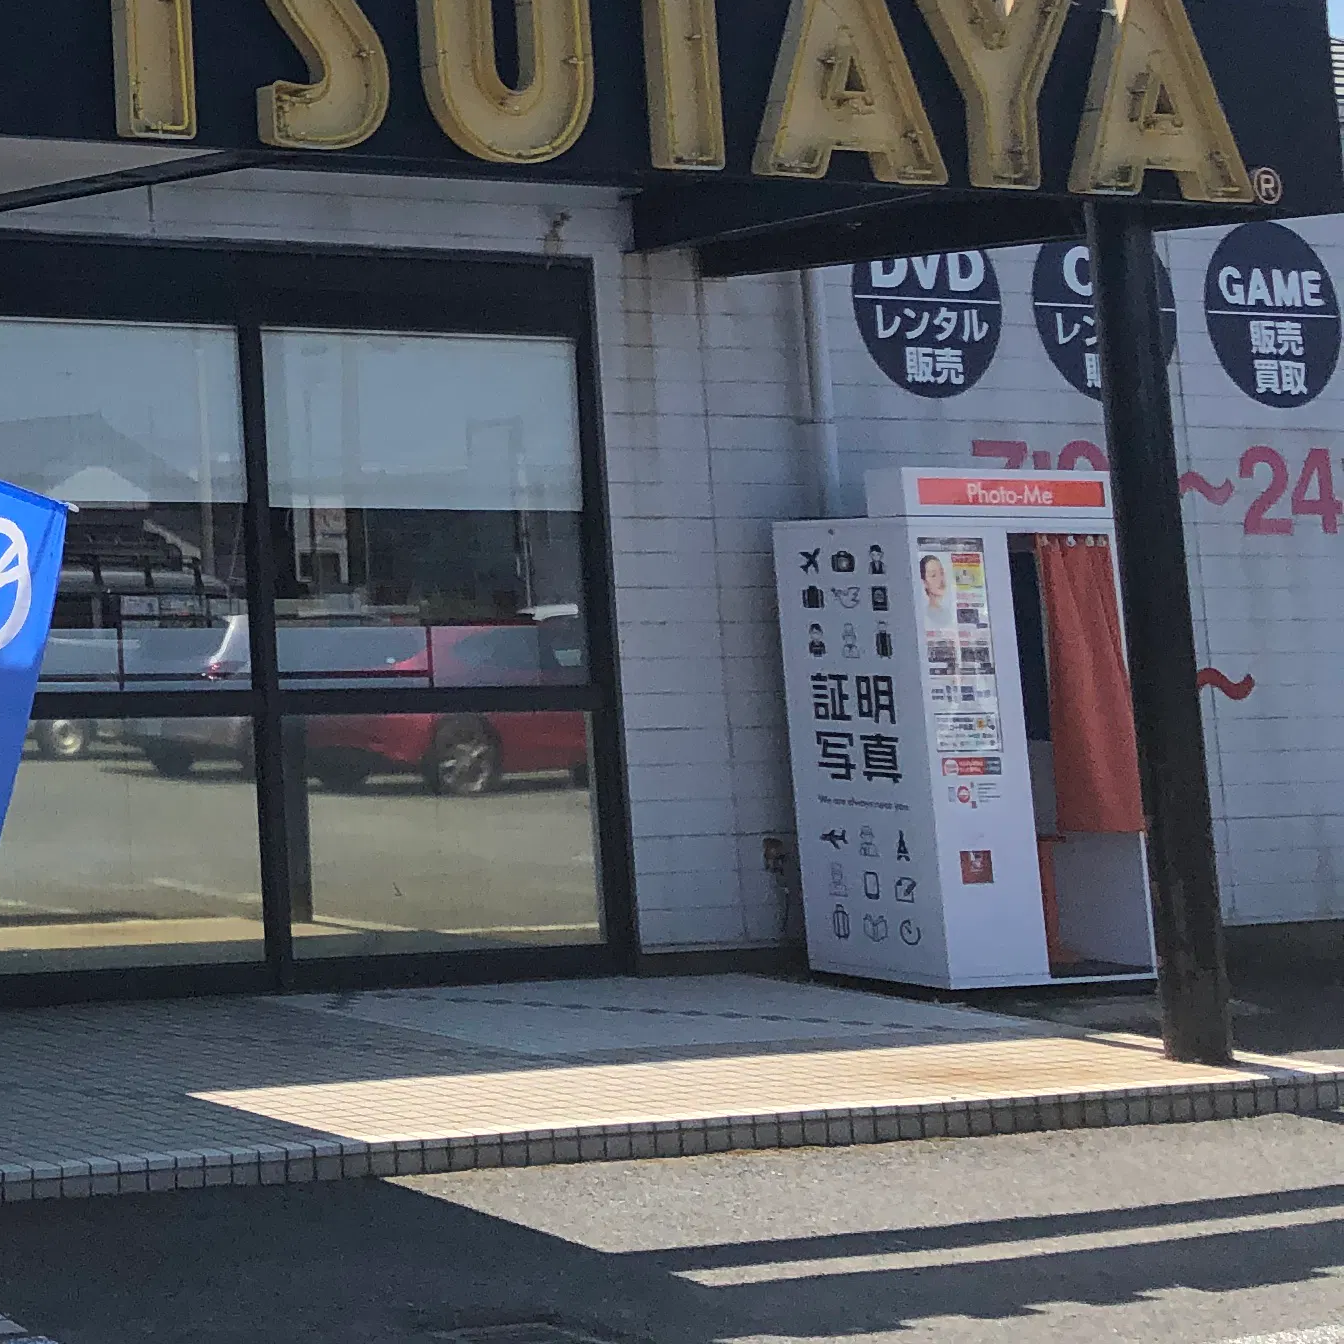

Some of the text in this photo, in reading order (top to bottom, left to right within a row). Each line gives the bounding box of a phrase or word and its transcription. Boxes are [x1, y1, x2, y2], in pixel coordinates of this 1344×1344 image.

[870, 248, 986, 294] DVD
[1218, 265, 1326, 308] GAME
[874, 304, 989, 342] レンタル
[1250, 319, 1305, 356] 販売
[905, 345, 965, 386] 販売
[1253, 358, 1309, 396] 買取
[966, 481, 1054, 507] Photo-Me
[811, 672, 897, 725] 証明
[815, 730, 903, 784] 写真
